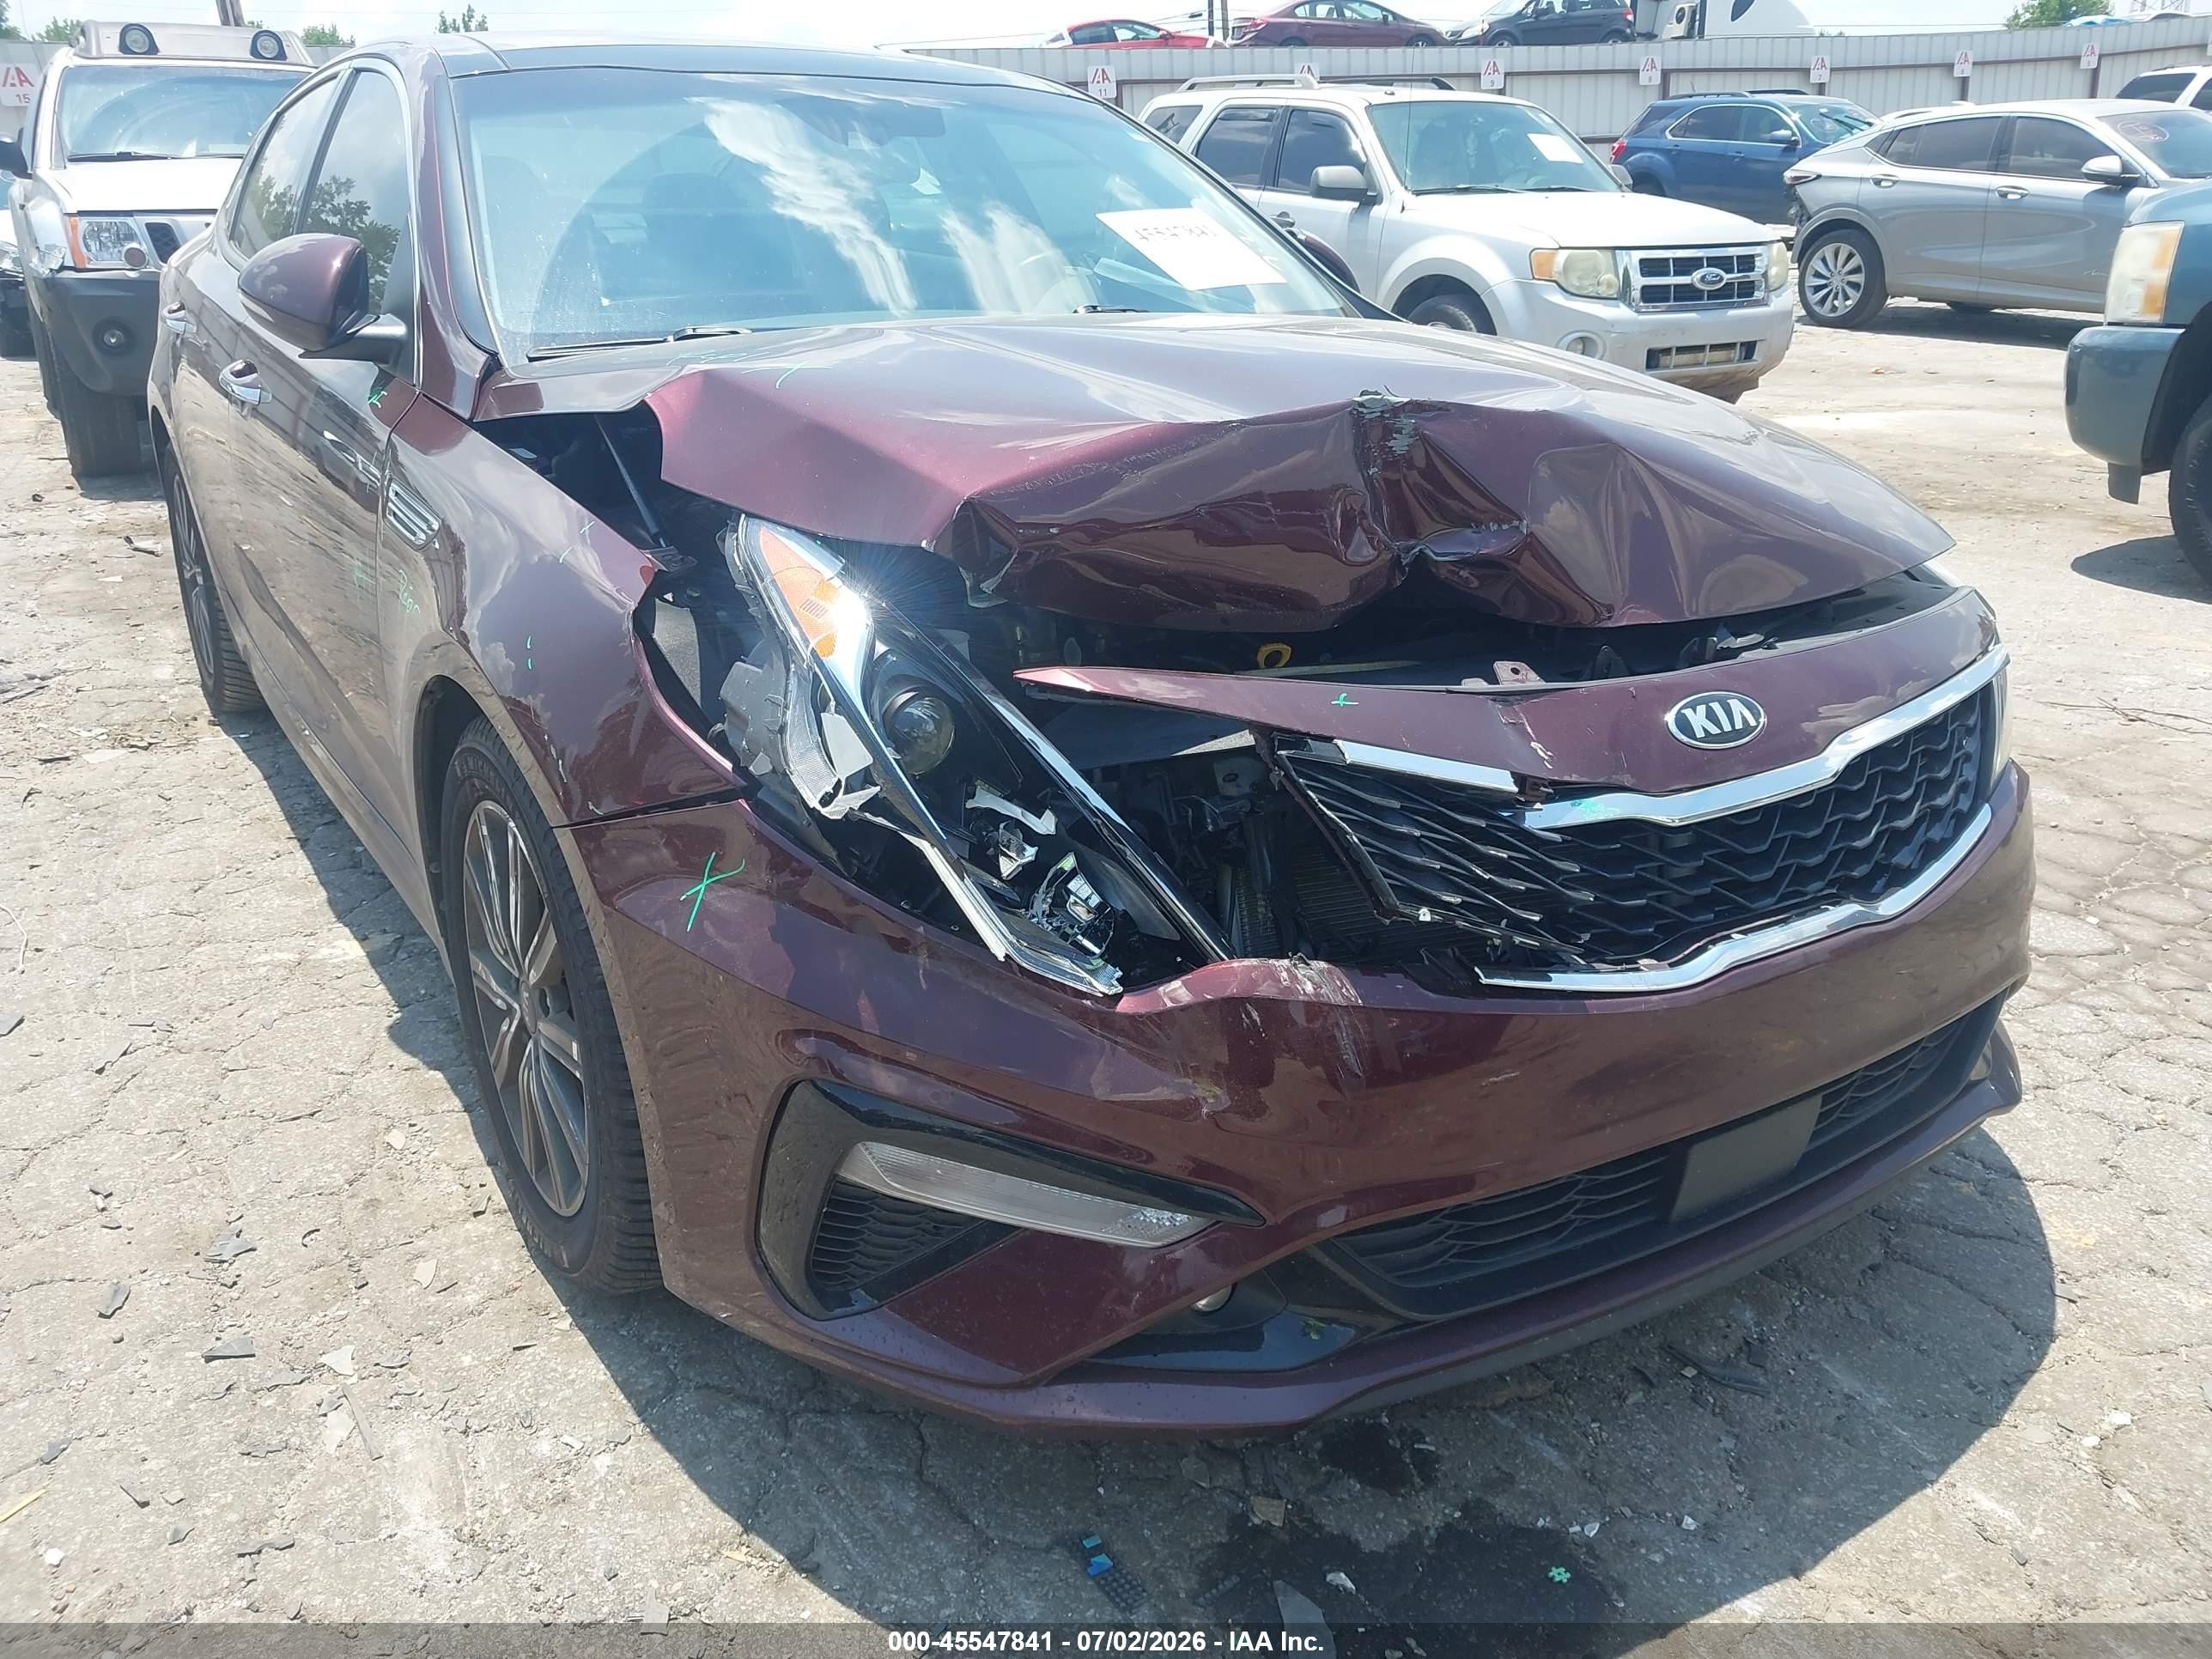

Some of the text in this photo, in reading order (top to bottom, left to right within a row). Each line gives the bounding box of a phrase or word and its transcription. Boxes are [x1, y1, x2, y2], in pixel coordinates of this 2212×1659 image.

[1098, 88, 1108, 97] 11
[15, 94, 31, 104] 15
[1680, 698, 1757, 738] KIA
